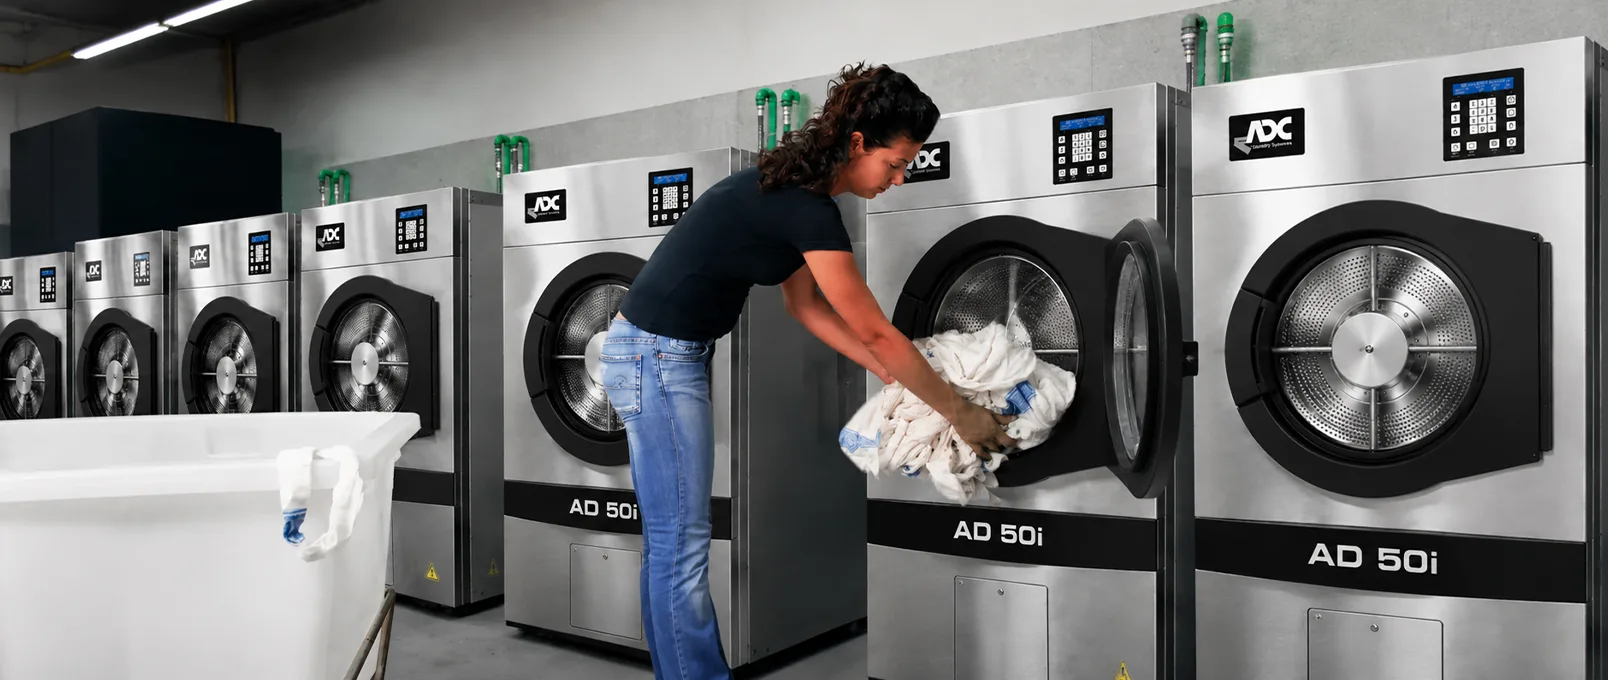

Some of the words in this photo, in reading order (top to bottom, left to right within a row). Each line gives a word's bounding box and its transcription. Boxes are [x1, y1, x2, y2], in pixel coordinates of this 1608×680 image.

[1246, 116, 1292, 143] ADC
[534, 195, 560, 212] ADC
[569, 499, 599, 516] AD
[606, 501, 638, 520] 50i
[953, 520, 991, 542] AD
[1001, 523, 1043, 547] 50i
[1308, 543, 1363, 568] AD
[1378, 547, 1438, 574] 50i
